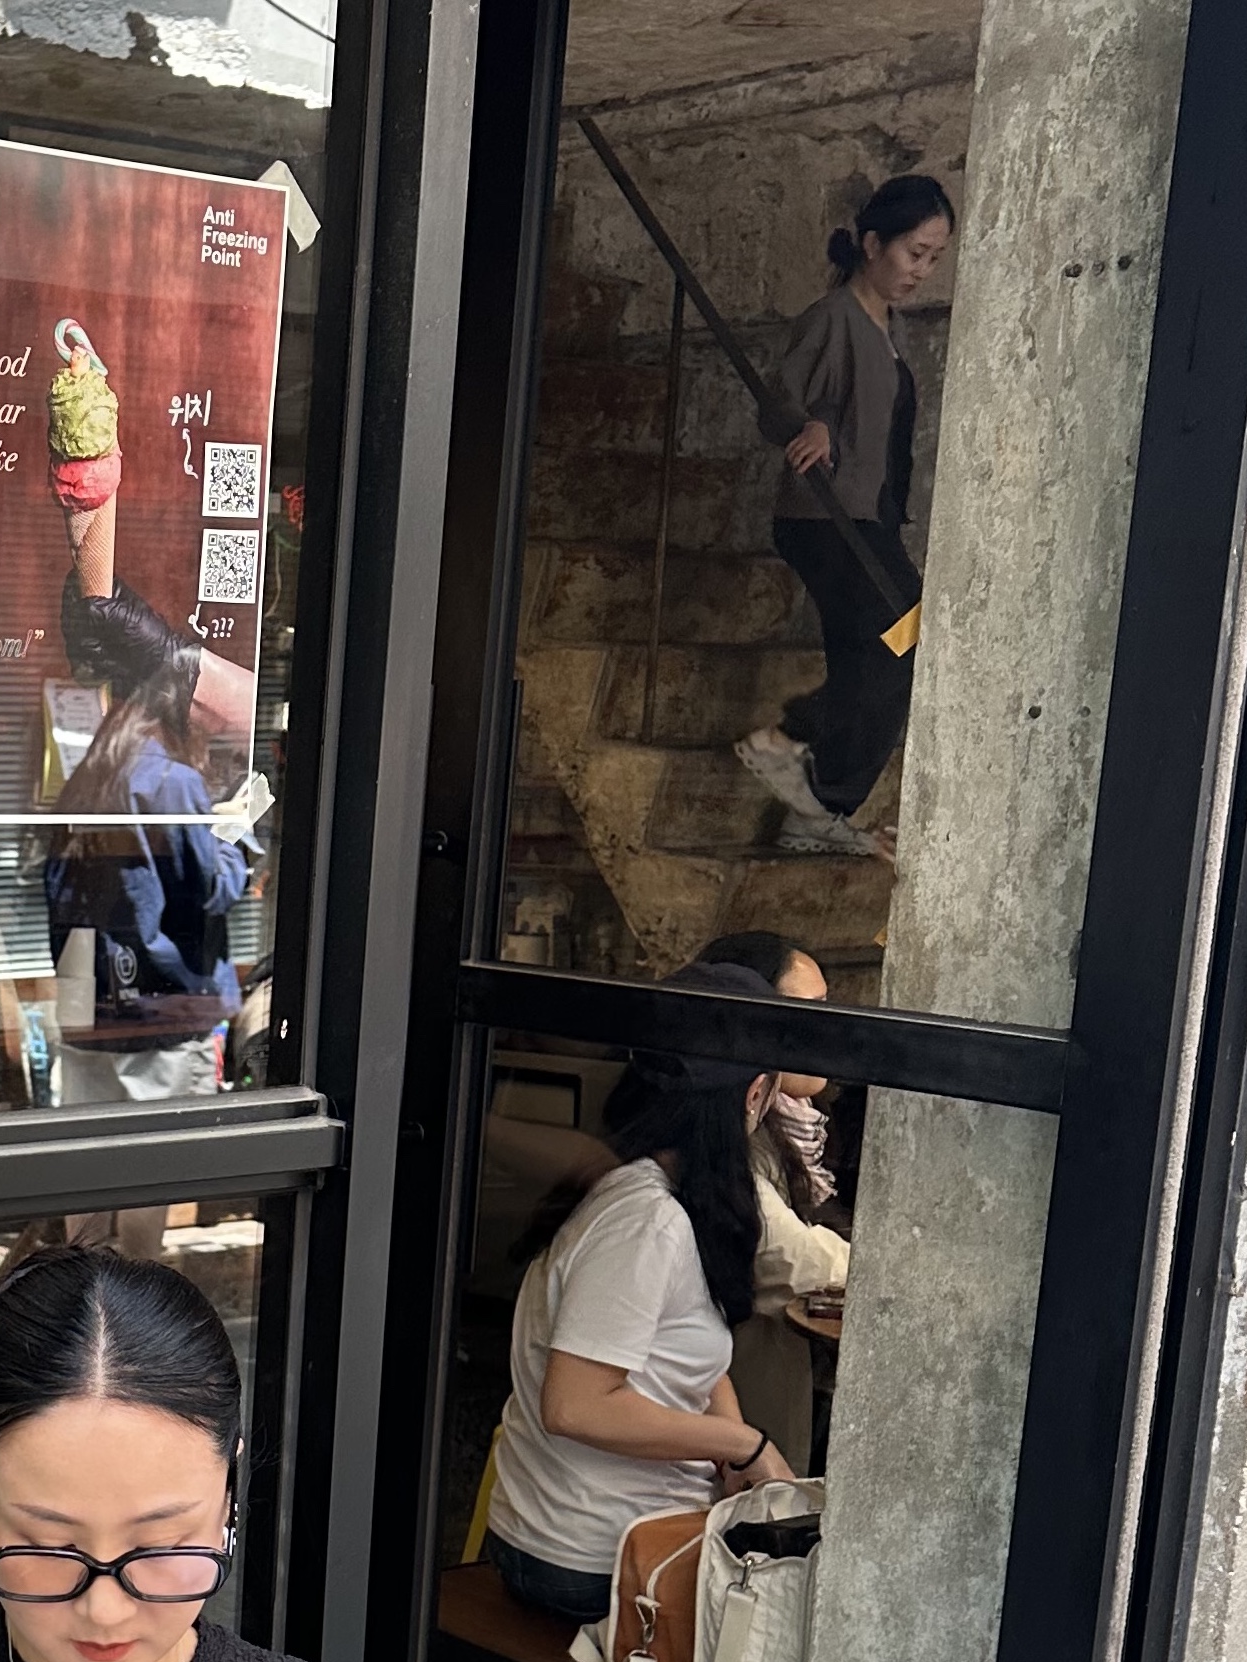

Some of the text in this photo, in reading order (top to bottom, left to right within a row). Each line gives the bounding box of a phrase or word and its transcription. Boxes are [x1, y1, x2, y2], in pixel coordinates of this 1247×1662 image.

[203, 205, 235, 227] Anti
[202, 225, 268, 255] Freezing
[201, 244, 242, 267] Point
[168, 389, 211, 426] 위치
